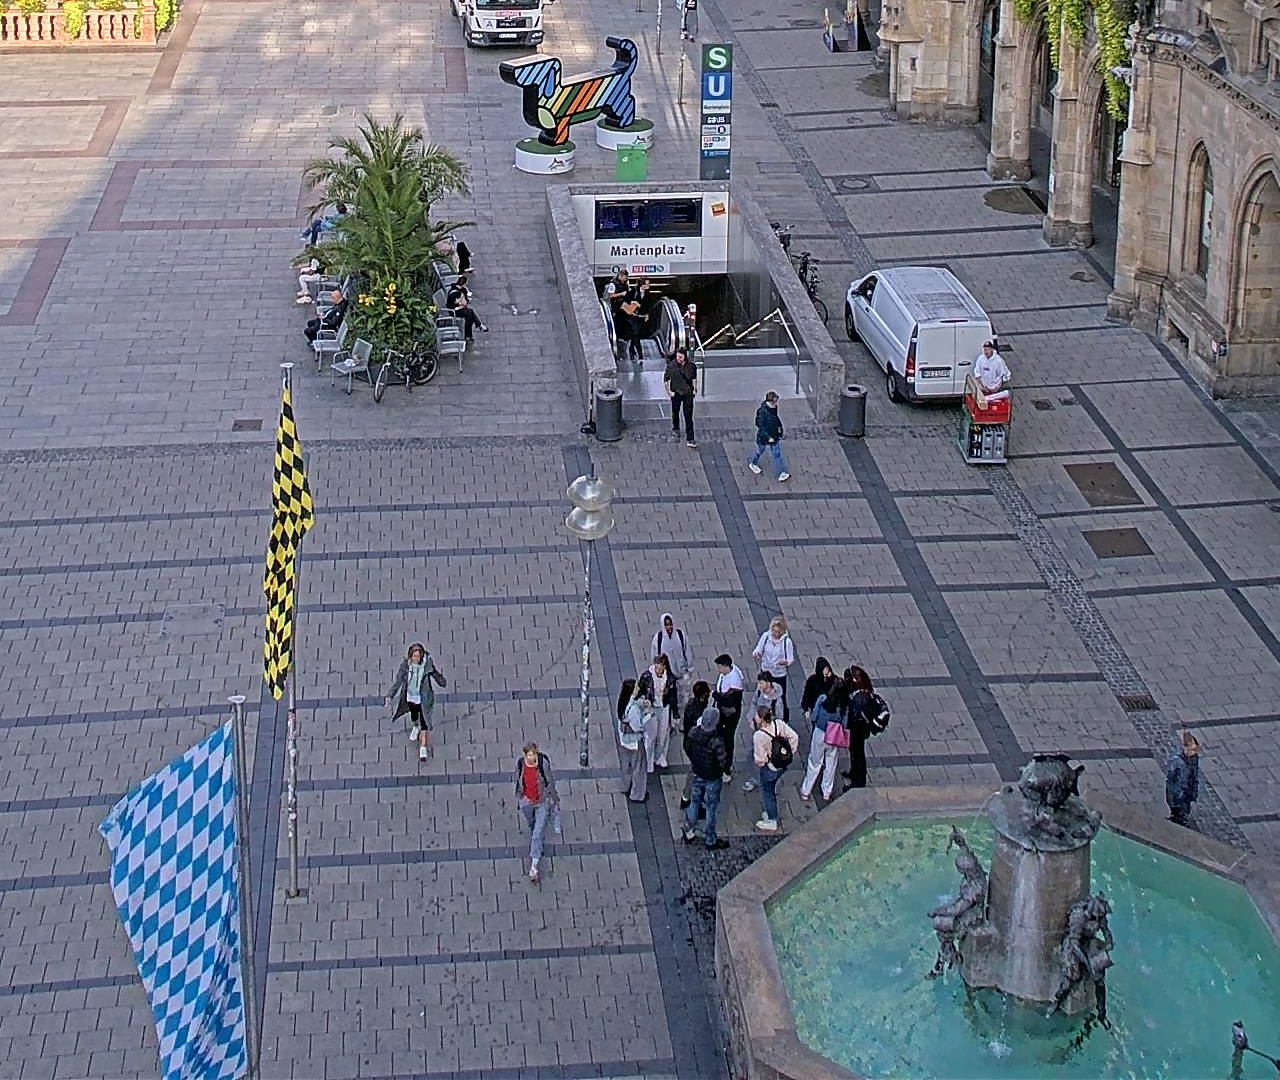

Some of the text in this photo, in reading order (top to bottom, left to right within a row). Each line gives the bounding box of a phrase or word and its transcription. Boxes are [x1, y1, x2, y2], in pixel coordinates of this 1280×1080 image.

[708, 47, 727, 69] S
[708, 75, 725, 97] U
[610, 243, 686, 258] Marienplatz
